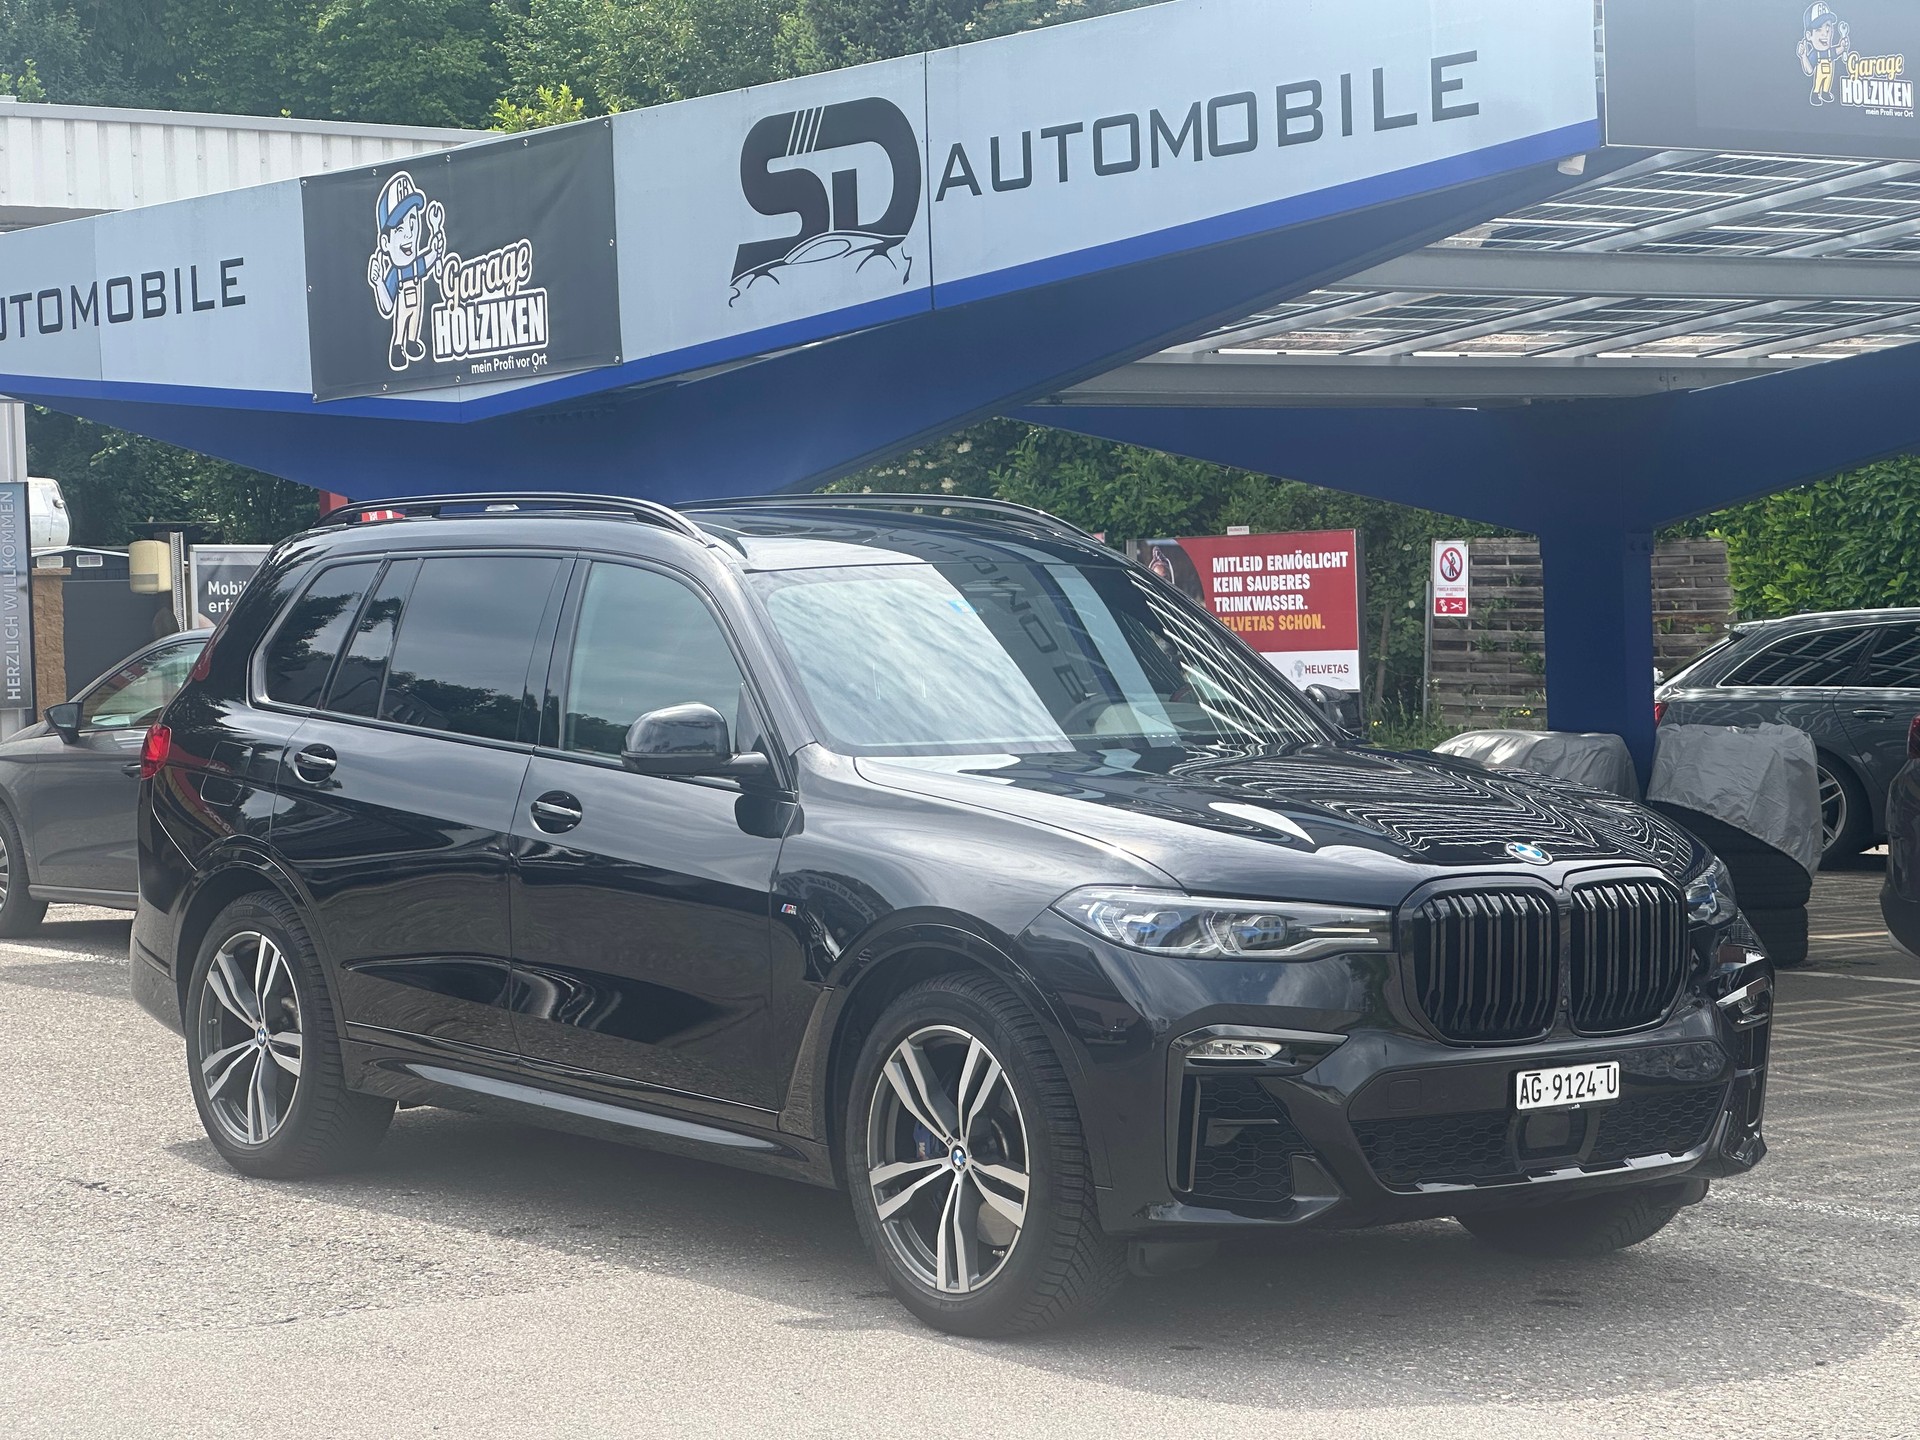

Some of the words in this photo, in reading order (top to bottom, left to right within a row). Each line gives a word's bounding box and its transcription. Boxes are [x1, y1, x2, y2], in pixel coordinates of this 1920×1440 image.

[1847, 53, 1904, 81] Garage
[1841, 79, 1912, 107] HOLZIKEN
[1865, 107, 1879, 116] mein
[1880, 108, 1893, 117] Profi
[1904, 110, 1914, 118] Ort
[935, 50, 1480, 203] AUTOMOBILE
[443, 246, 529, 314] Garage
[0, 257, 246, 342] TOMOBILE
[434, 295, 546, 356] HOLZIKEN
[471, 360, 492, 374] mein
[493, 355, 515, 371] Profi
[516, 357, 531, 369] vor
[531, 353, 547, 366] Ort
[0, 490, 19, 612] WILLKOMMEN
[1212, 556, 1263, 573] MITLEID
[1267, 550, 1349, 571] ERMÖGLICHT
[1213, 576, 1243, 593] KEIN
[1246, 573, 1310, 592] SAUBERES
[208, 598, 233, 613] erf
[1214, 594, 1309, 613] TRINKWASSER.
[1278, 613, 1326, 630] SCHON.
[4, 616, 21, 700] HERZLICH
[1304, 663, 1350, 674] HELVETAS
